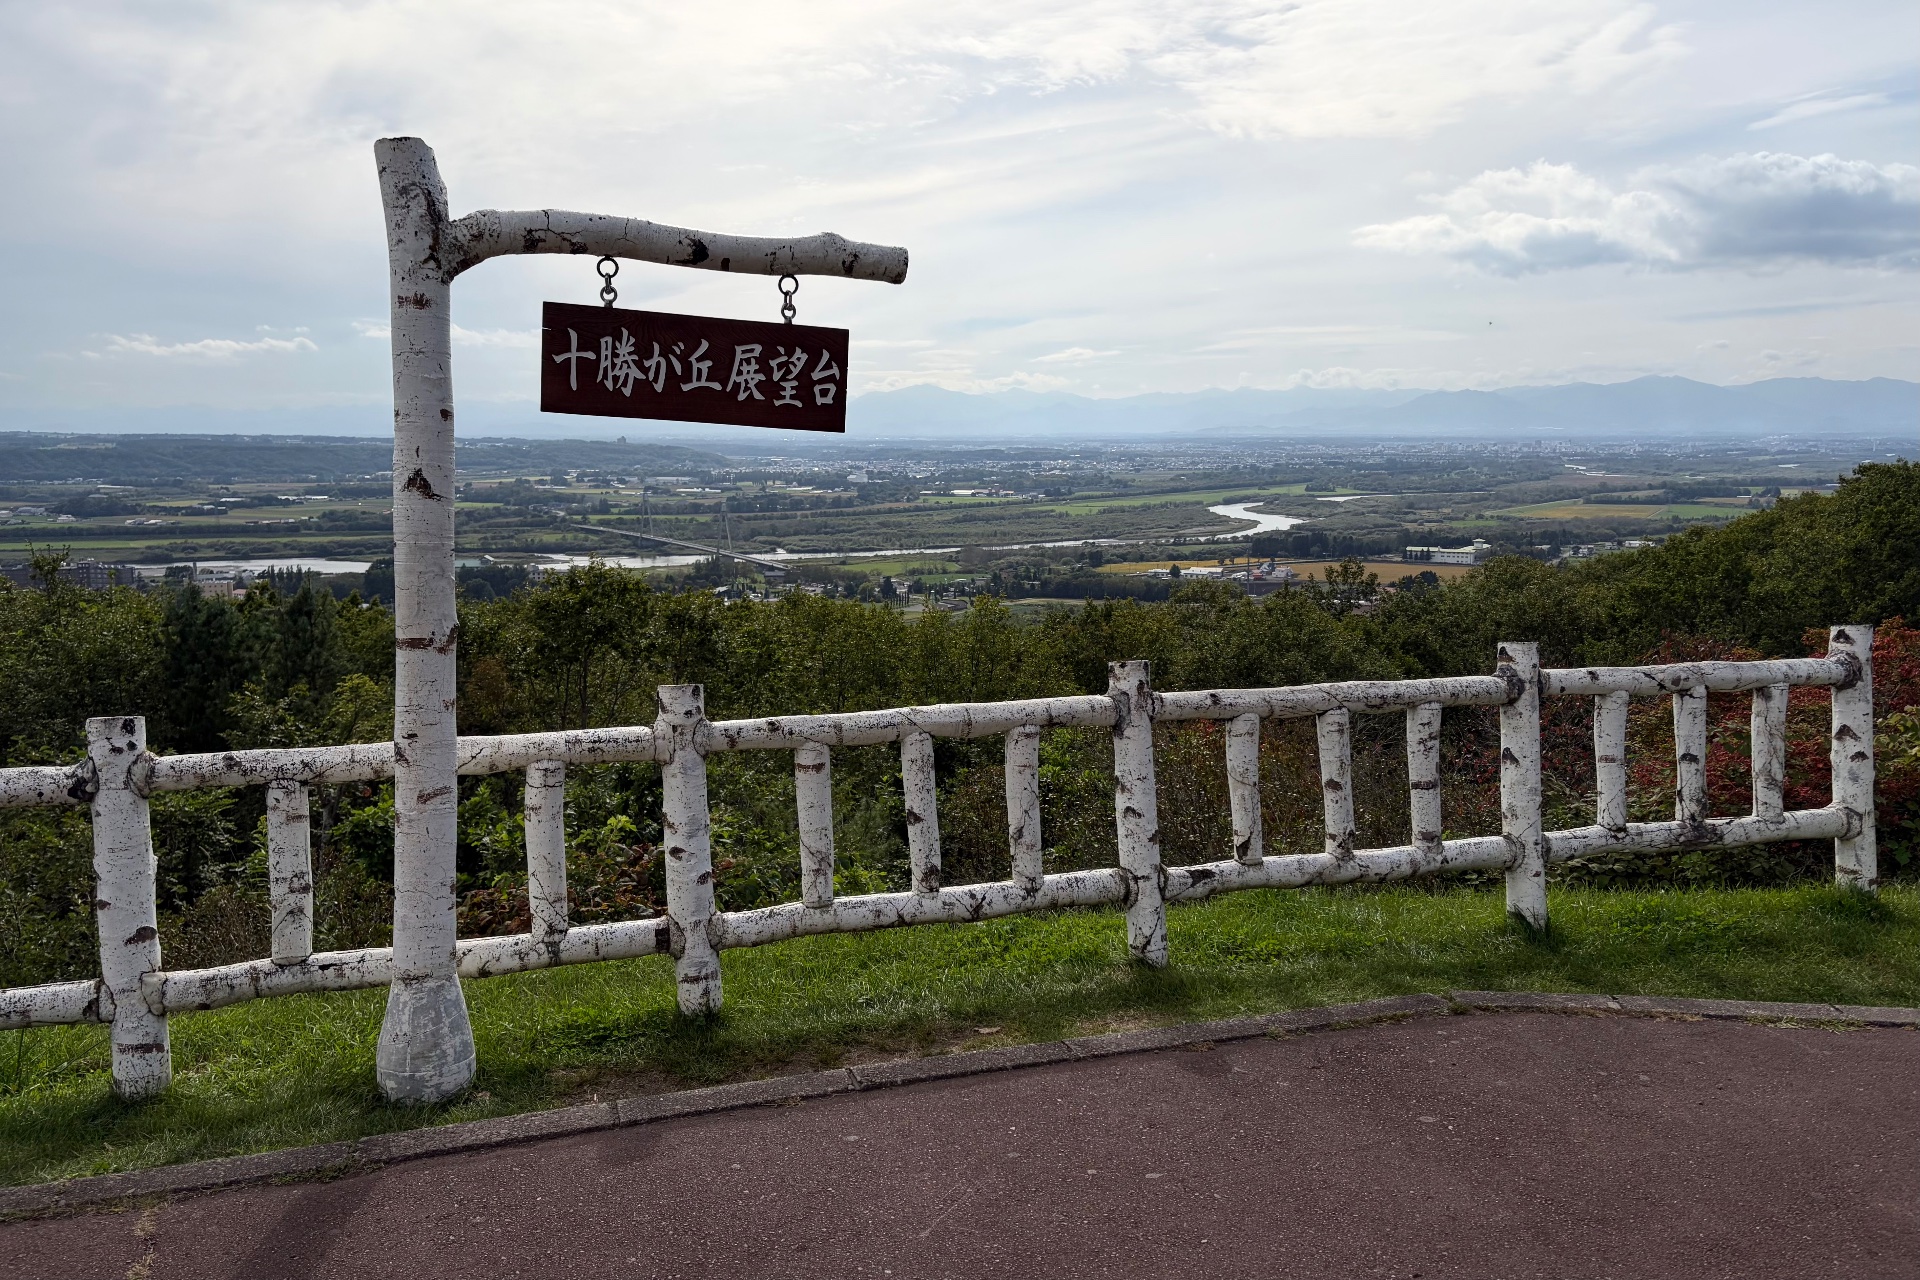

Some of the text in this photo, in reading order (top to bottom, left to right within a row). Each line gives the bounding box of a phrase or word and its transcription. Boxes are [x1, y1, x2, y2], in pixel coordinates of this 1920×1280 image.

[551, 327, 840, 408] 十勝が丘展望台
